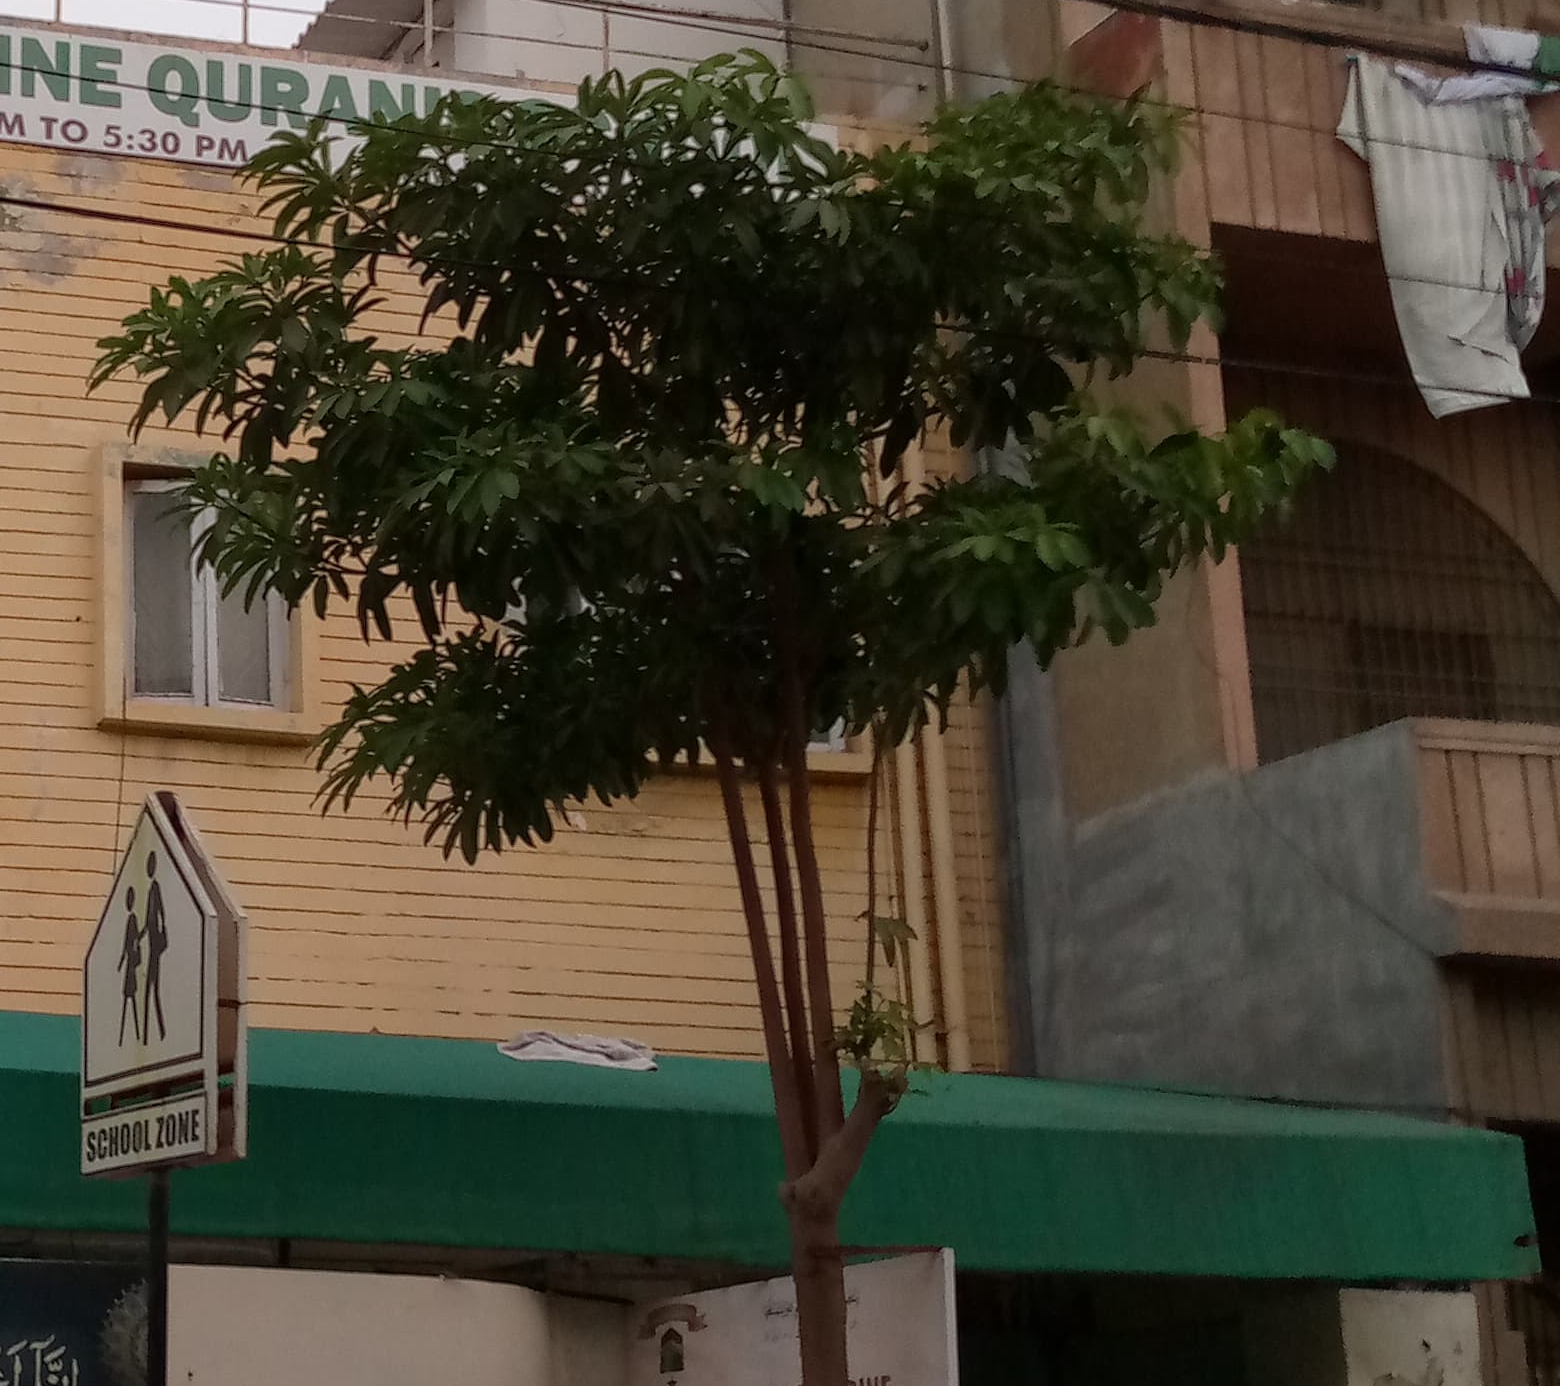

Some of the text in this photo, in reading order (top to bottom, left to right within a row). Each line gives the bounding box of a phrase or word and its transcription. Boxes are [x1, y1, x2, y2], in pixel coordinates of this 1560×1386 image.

[146, 53, 486, 141] QURANI
[42, 117, 90, 146] TO
[102, 123, 180, 159] 5:30
[194, 134, 249, 164] PM
[86, 1108, 201, 1163] SCHOOL ZONE
